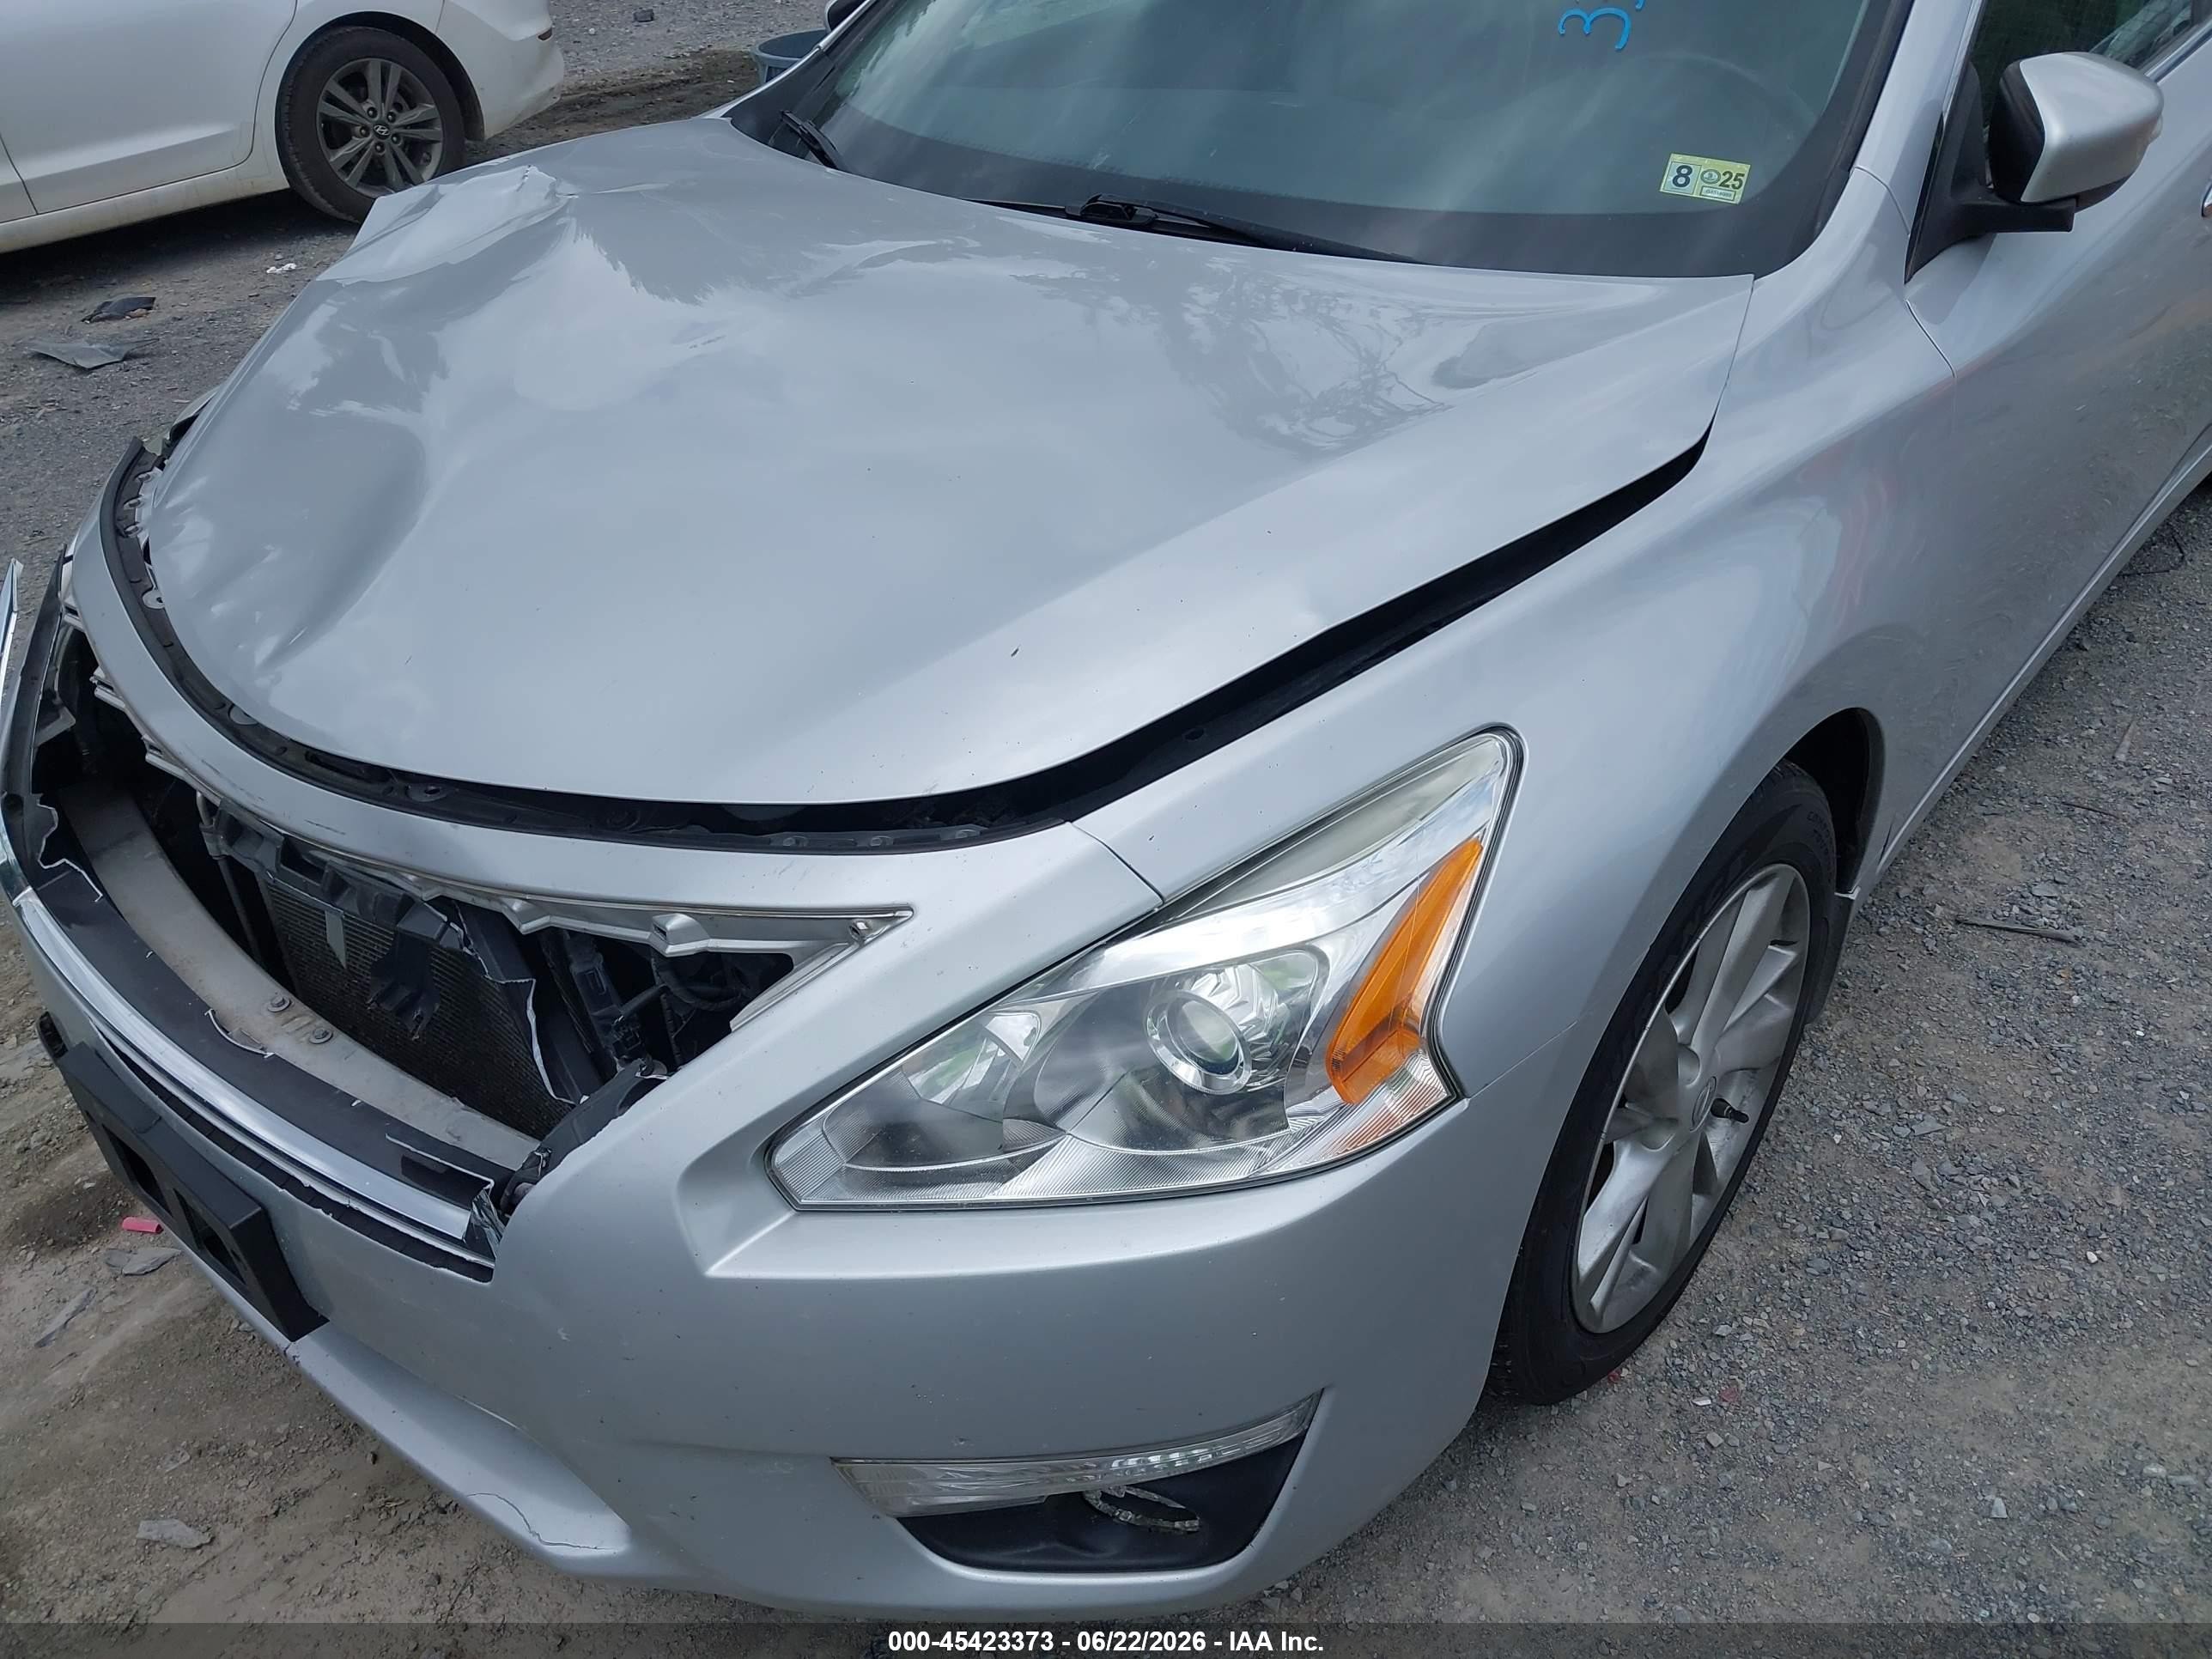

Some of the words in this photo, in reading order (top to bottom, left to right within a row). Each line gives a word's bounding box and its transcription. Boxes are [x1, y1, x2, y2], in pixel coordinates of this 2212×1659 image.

[1558, 0, 1646, 51] 3
[1672, 165, 1693, 188] 8
[1718, 171, 1746, 190] 25
